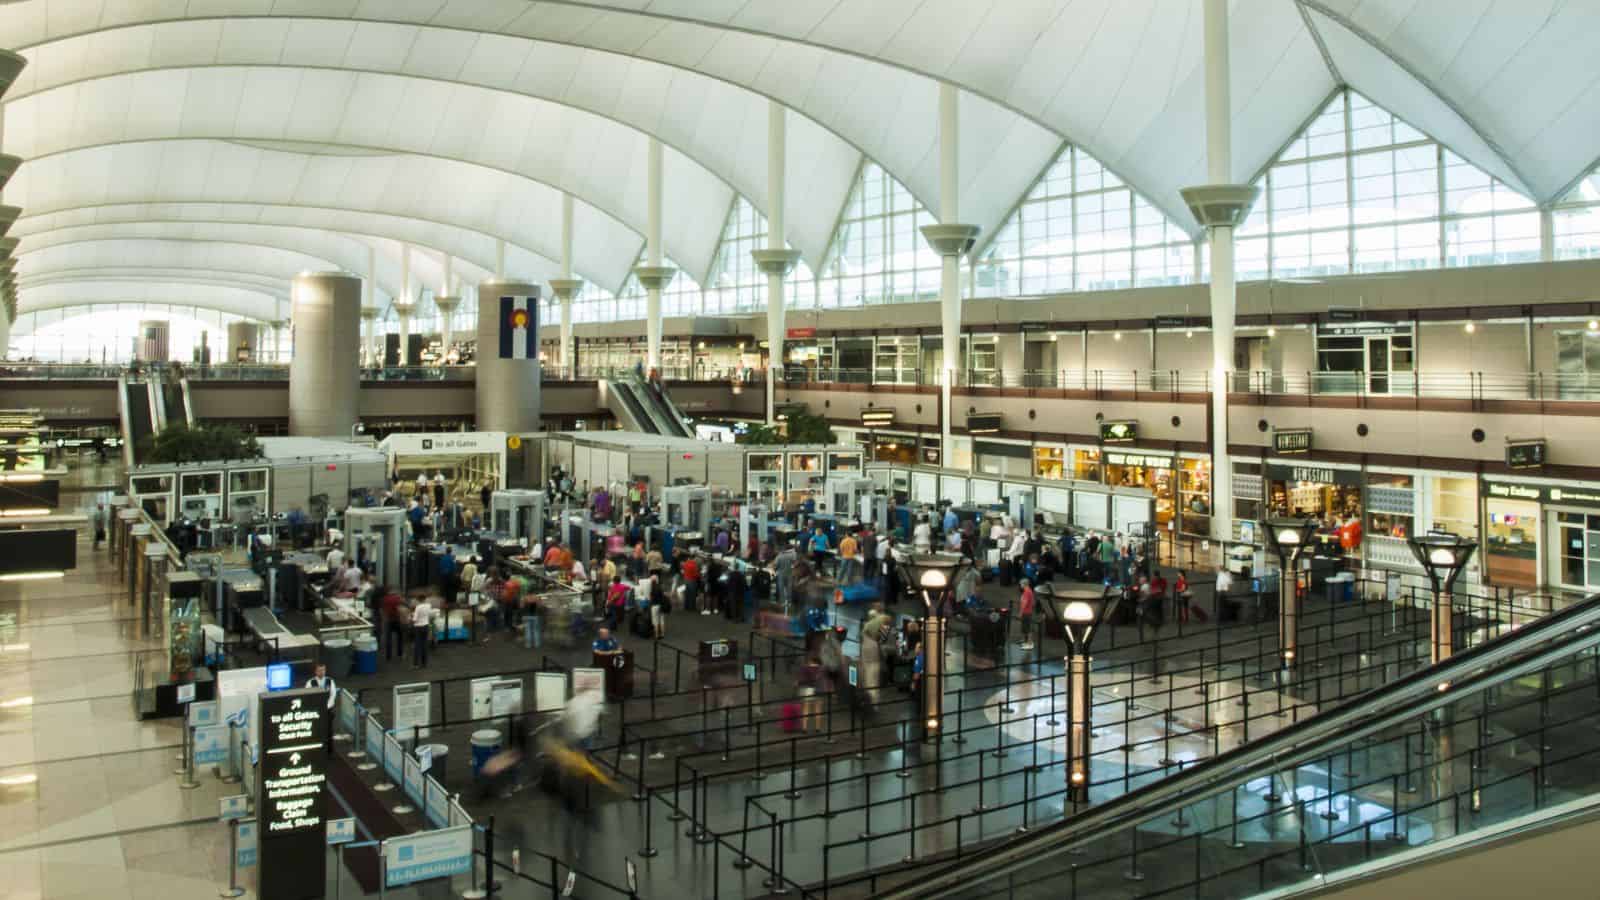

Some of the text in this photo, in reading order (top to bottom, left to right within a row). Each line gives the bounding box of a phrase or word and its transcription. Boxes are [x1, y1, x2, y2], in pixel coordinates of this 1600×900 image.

[446, 440, 455, 448] all
[456, 440, 477, 448] Gates
[282, 712, 293, 722] all
[279, 721, 313, 733] Security
[279, 765, 312, 778] Ground
[265, 774, 325, 788] Transportation
[276, 798, 314, 811] Baggage
[283, 809, 307, 819] Claim
[294, 817, 320, 828] Shops
